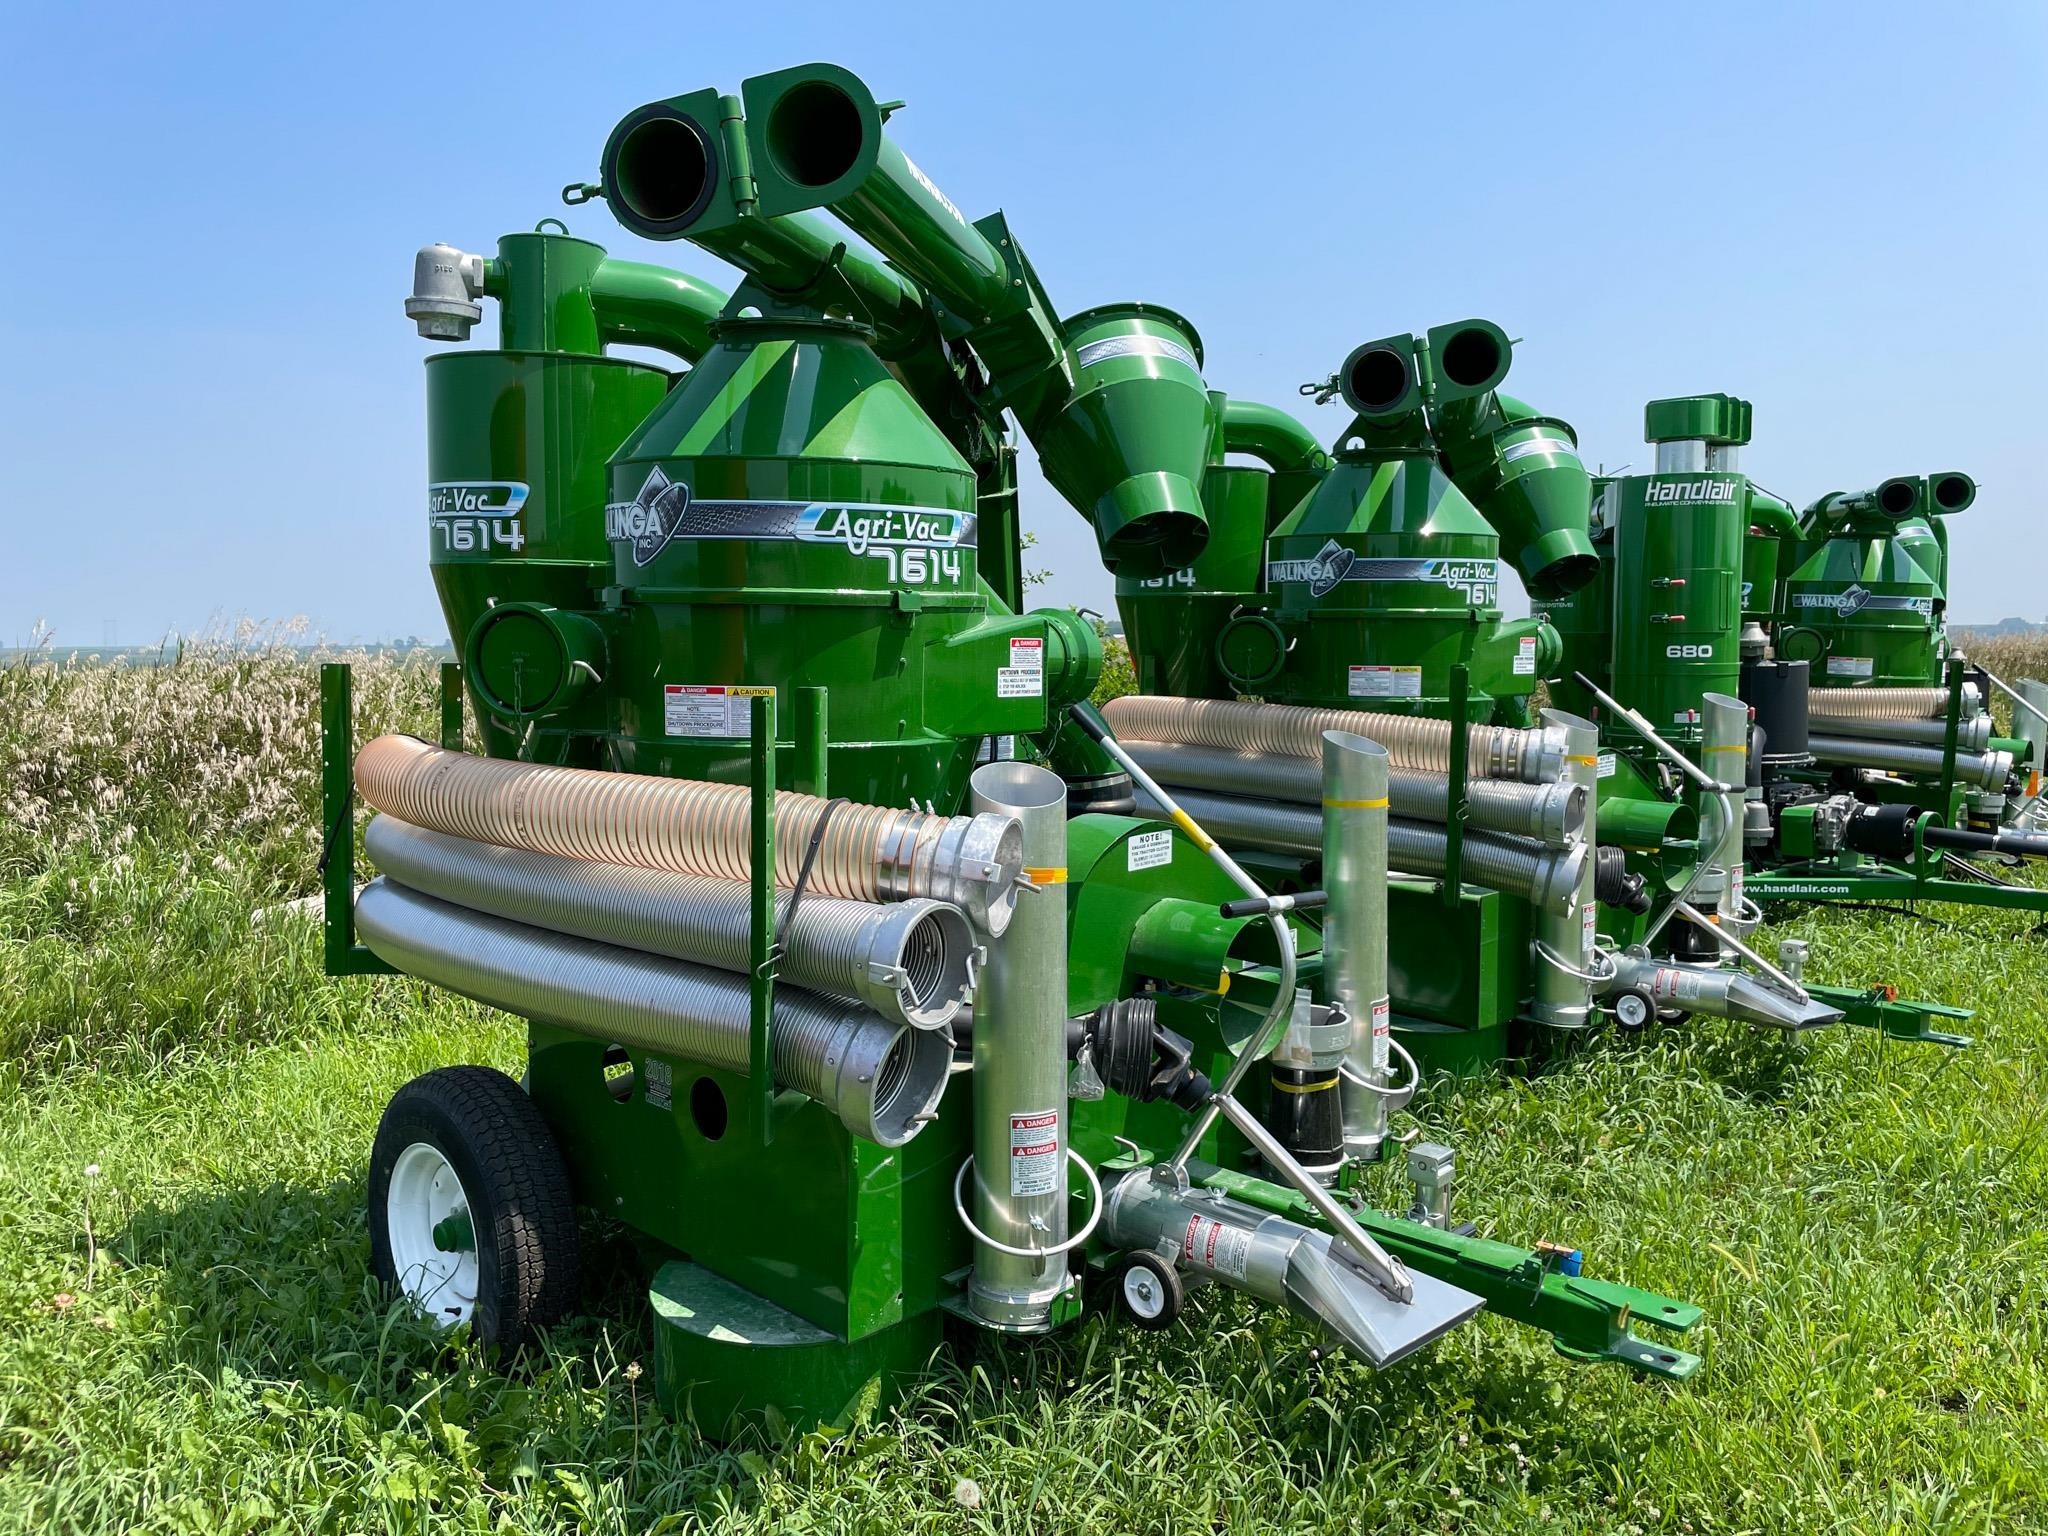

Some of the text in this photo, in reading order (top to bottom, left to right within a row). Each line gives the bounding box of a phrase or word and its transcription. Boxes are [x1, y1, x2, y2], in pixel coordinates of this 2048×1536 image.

[1645, 478, 1737, 502] Handlair
[430, 488, 489, 528] gri-Vac
[435, 519, 524, 551] 7614
[833, 509, 940, 555] Agri-Vac
[638, 539, 653, 549] INC.
[867, 546, 960, 584] 7614
[1272, 561, 1336, 580] WALINGA
[1440, 562, 1491, 589] Agri-Vac
[1456, 584, 1496, 605] 7614
[1801, 595, 1857, 608] WALINGA
[1667, 645, 1712, 658] 680
[1140, 833, 1162, 843] NOTE!
[1026, 1116, 1055, 1127] DANGER
[1026, 1143, 1055, 1155] DANGER
[1187, 1218, 1198, 1248] DANGER
[1208, 1226, 1219, 1256] DANGER
